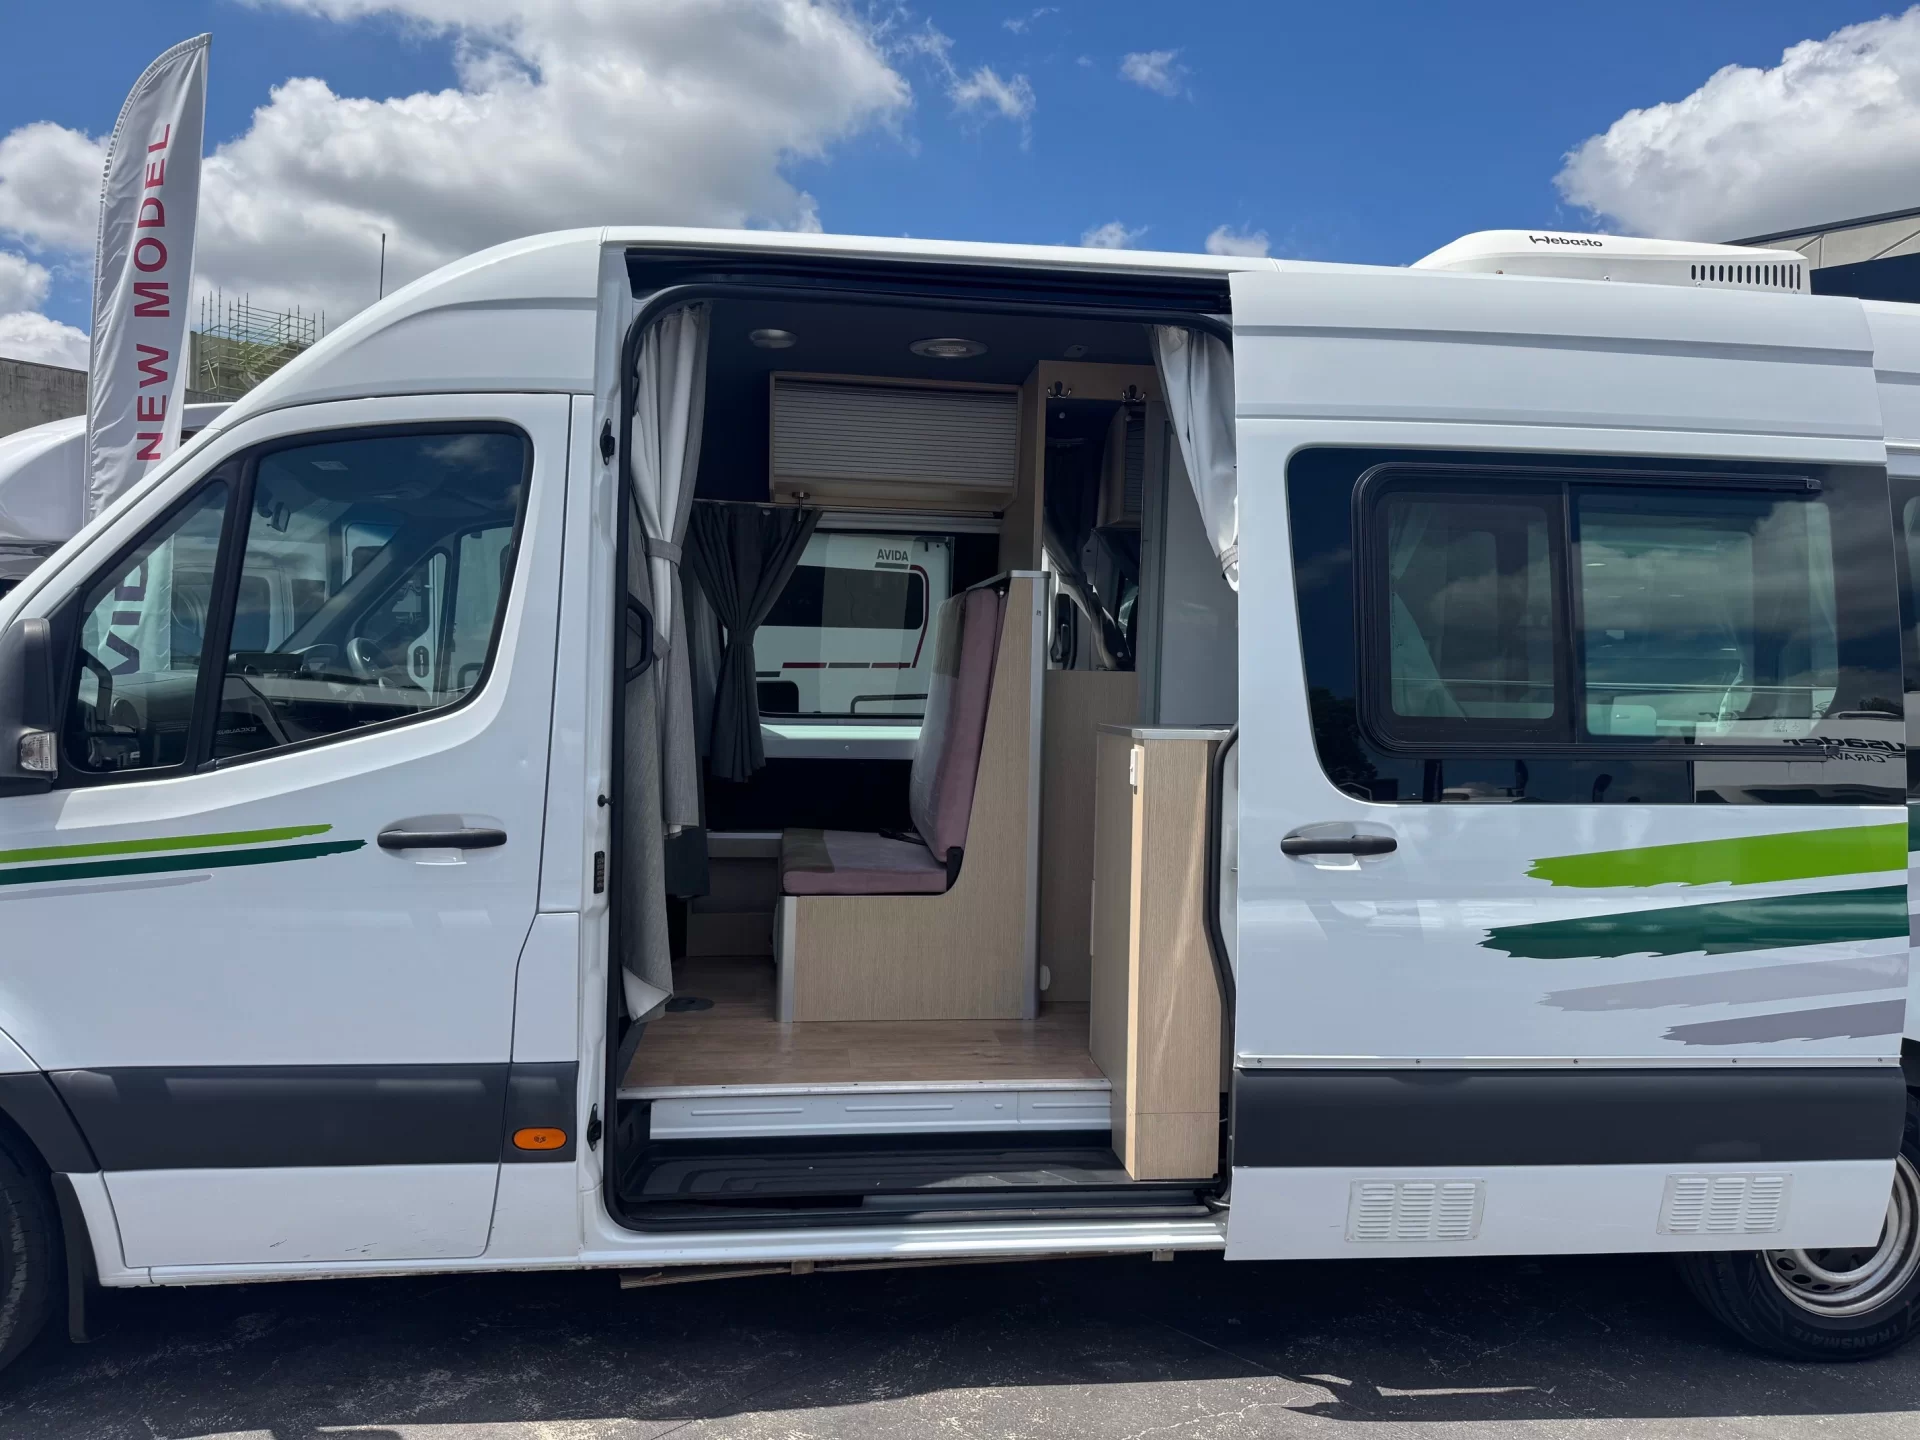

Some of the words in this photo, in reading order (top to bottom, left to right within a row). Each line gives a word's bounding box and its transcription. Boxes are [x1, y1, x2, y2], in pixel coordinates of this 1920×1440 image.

[133, 123, 171, 318] MODEL
[1529, 235, 1603, 247] Webasto
[136, 343, 169, 461] NEW
[876, 548, 909, 562] AVIDA
